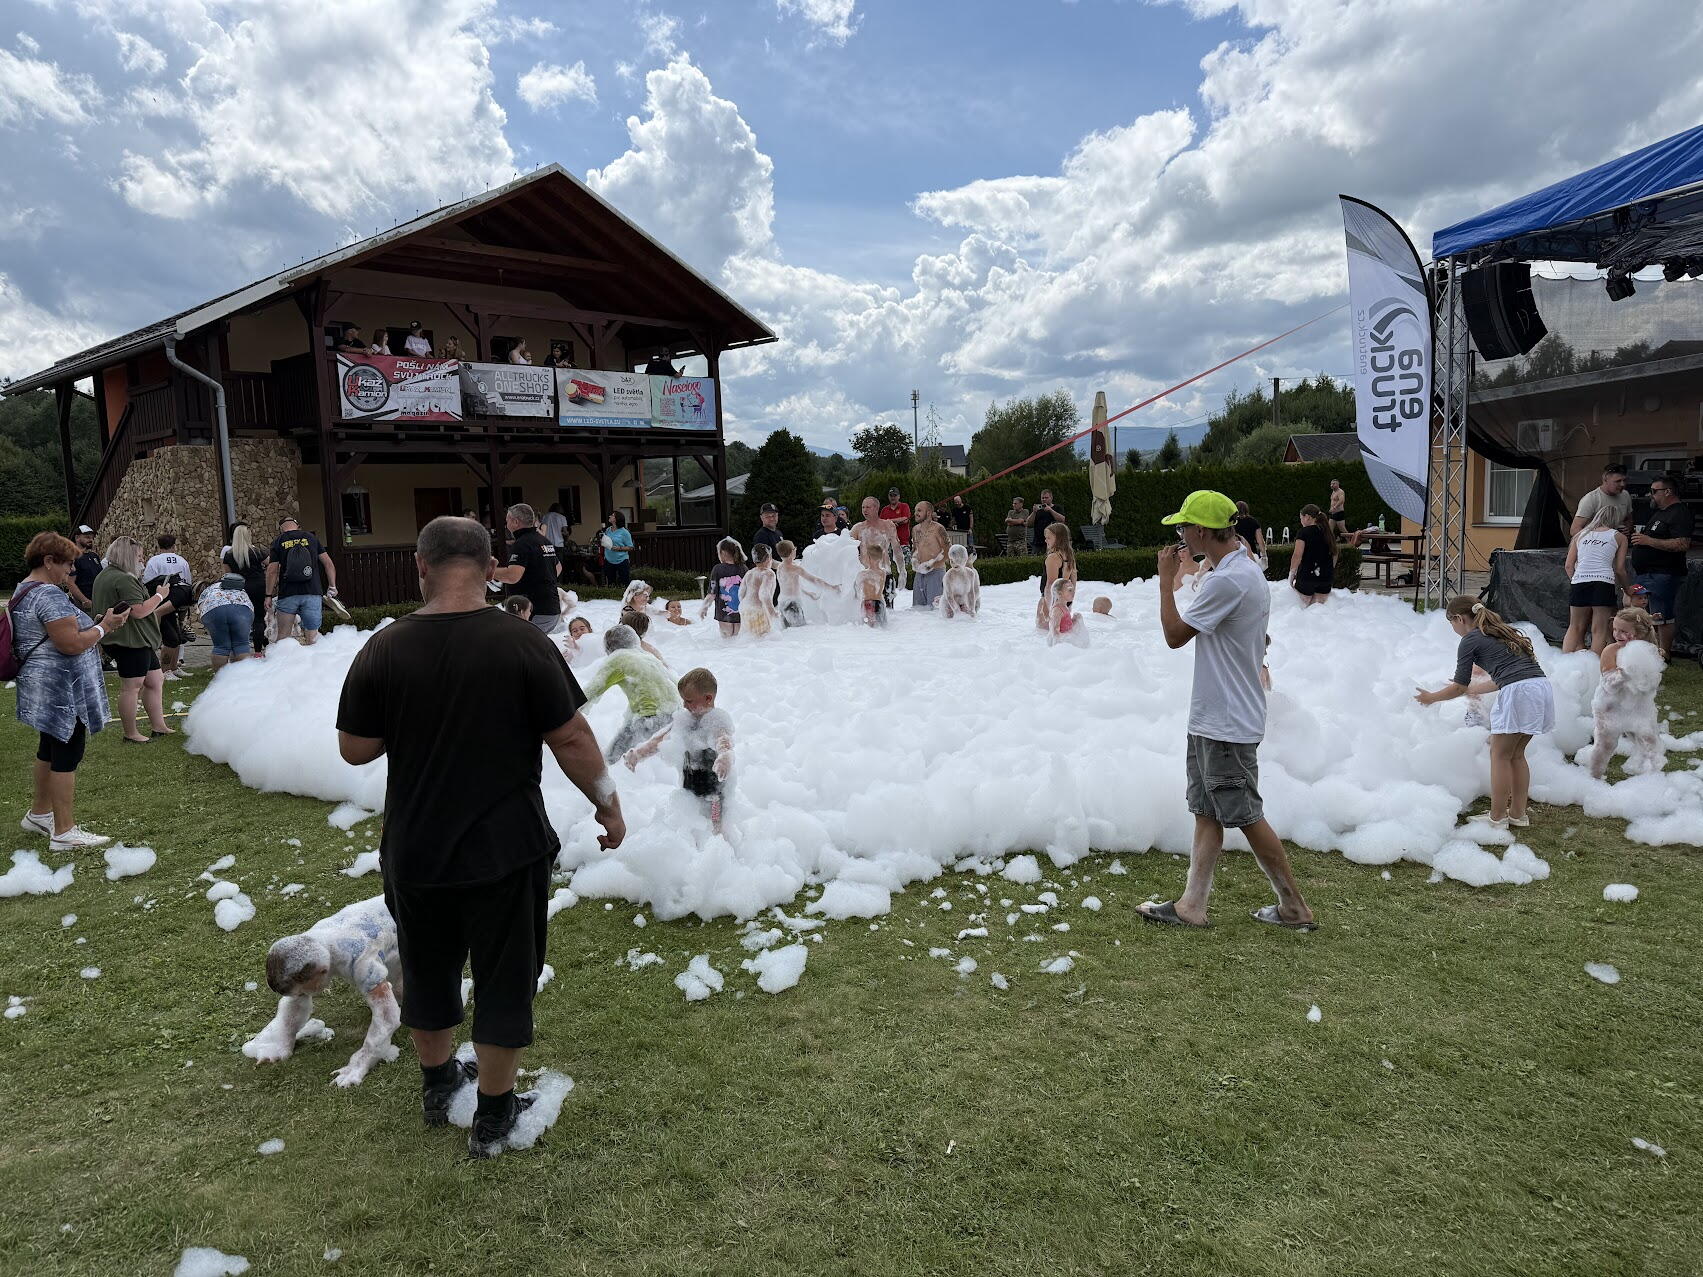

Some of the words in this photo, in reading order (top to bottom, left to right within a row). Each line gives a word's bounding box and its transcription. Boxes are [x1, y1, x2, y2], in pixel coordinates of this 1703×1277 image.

[396, 360, 424, 370] POŠLI
[347, 374, 384, 387] Ukaž
[347, 385, 388, 397] Kamion
[166, 556, 177, 564] 93
